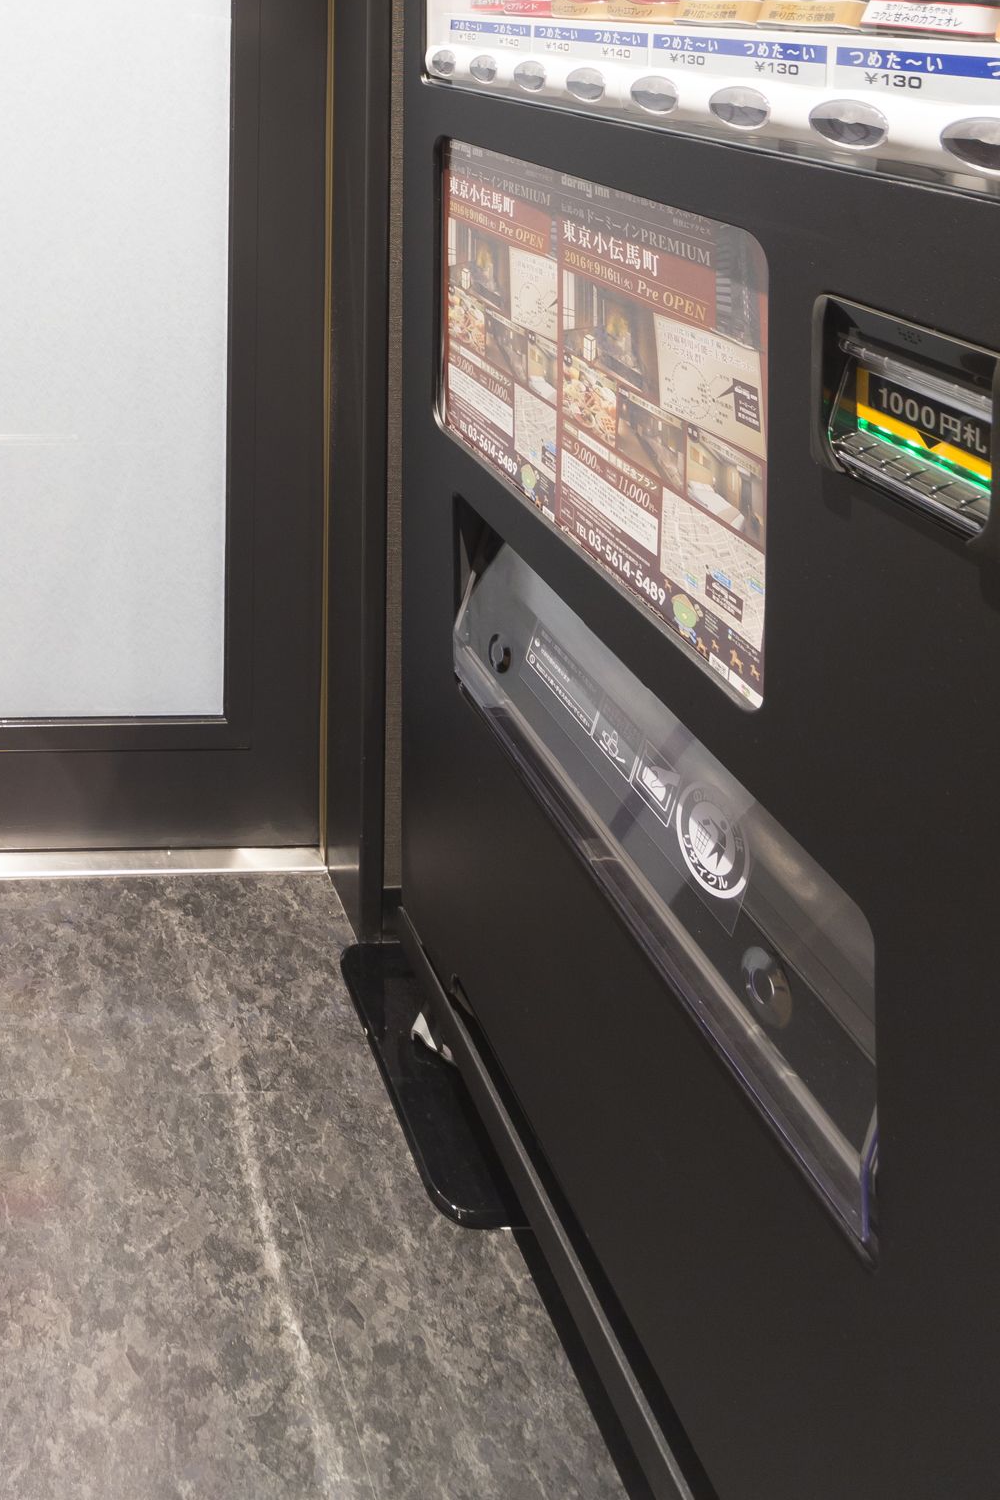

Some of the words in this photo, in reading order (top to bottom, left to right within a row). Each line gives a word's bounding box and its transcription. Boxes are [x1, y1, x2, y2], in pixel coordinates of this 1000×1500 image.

[454, 21, 482, 32] つめた～い
[871, 11, 963, 28] コクと甘みのカフェオレ
[493, 24, 527, 36] つめた～い
[539, 27, 578, 40] つめた～い
[594, 31, 641, 45] つめた～い
[545, 41, 570, 52] ¥140
[601, 47, 632, 59] ¥140
[661, 36, 718, 52] つめた～い
[743, 42, 816, 61] つめた～い
[669, 52, 706, 67] ¥130
[754, 61, 799, 76] ¥130
[849, 50, 944, 72] つめた～い
[864, 71, 923, 90] ¥130
[561, 174, 593, 198] dormy
[594, 184, 610, 199] inn
[450, 175, 516, 218] 東京小伝馬町
[499, 219, 514, 237] Pre
[515, 227, 545, 250] OPEN
[561, 219, 660, 278] 東京小伝馬町
[637, 278, 661, 302] Pre
[663, 290, 707, 323] OPEN
[878, 387, 988, 454] 1000円札
[467, 424, 518, 476] 03-5614-5489
[575, 520, 588, 541] TEL
[588, 529, 666, 606] 03-5614-5489
[683, 832, 729, 891] リサイクル
